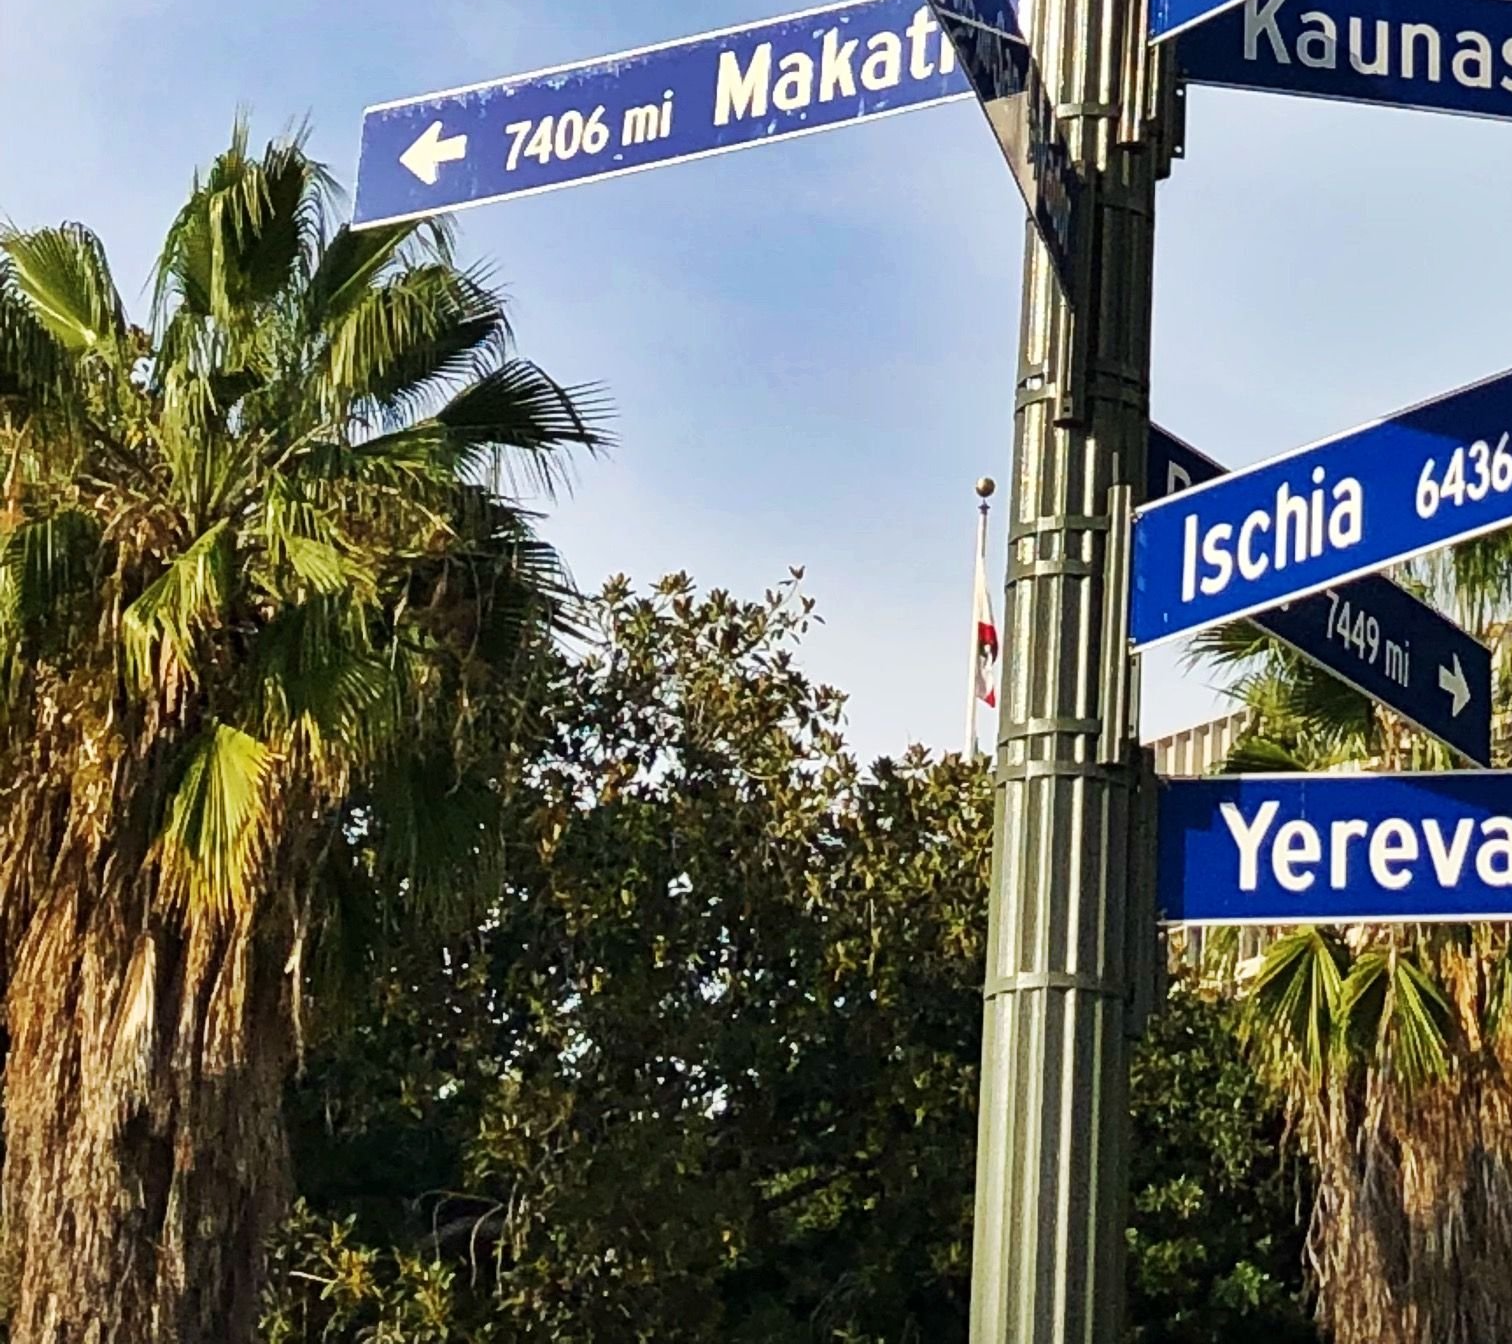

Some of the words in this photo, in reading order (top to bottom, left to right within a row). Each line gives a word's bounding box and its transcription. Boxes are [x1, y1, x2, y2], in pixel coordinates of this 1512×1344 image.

[504, 109, 609, 172] 7406
[620, 89, 674, 147] mi
[1181, 466, 1364, 603] Ischia
[1326, 588, 1380, 664] 7449
[1385, 639, 1410, 688] mi
